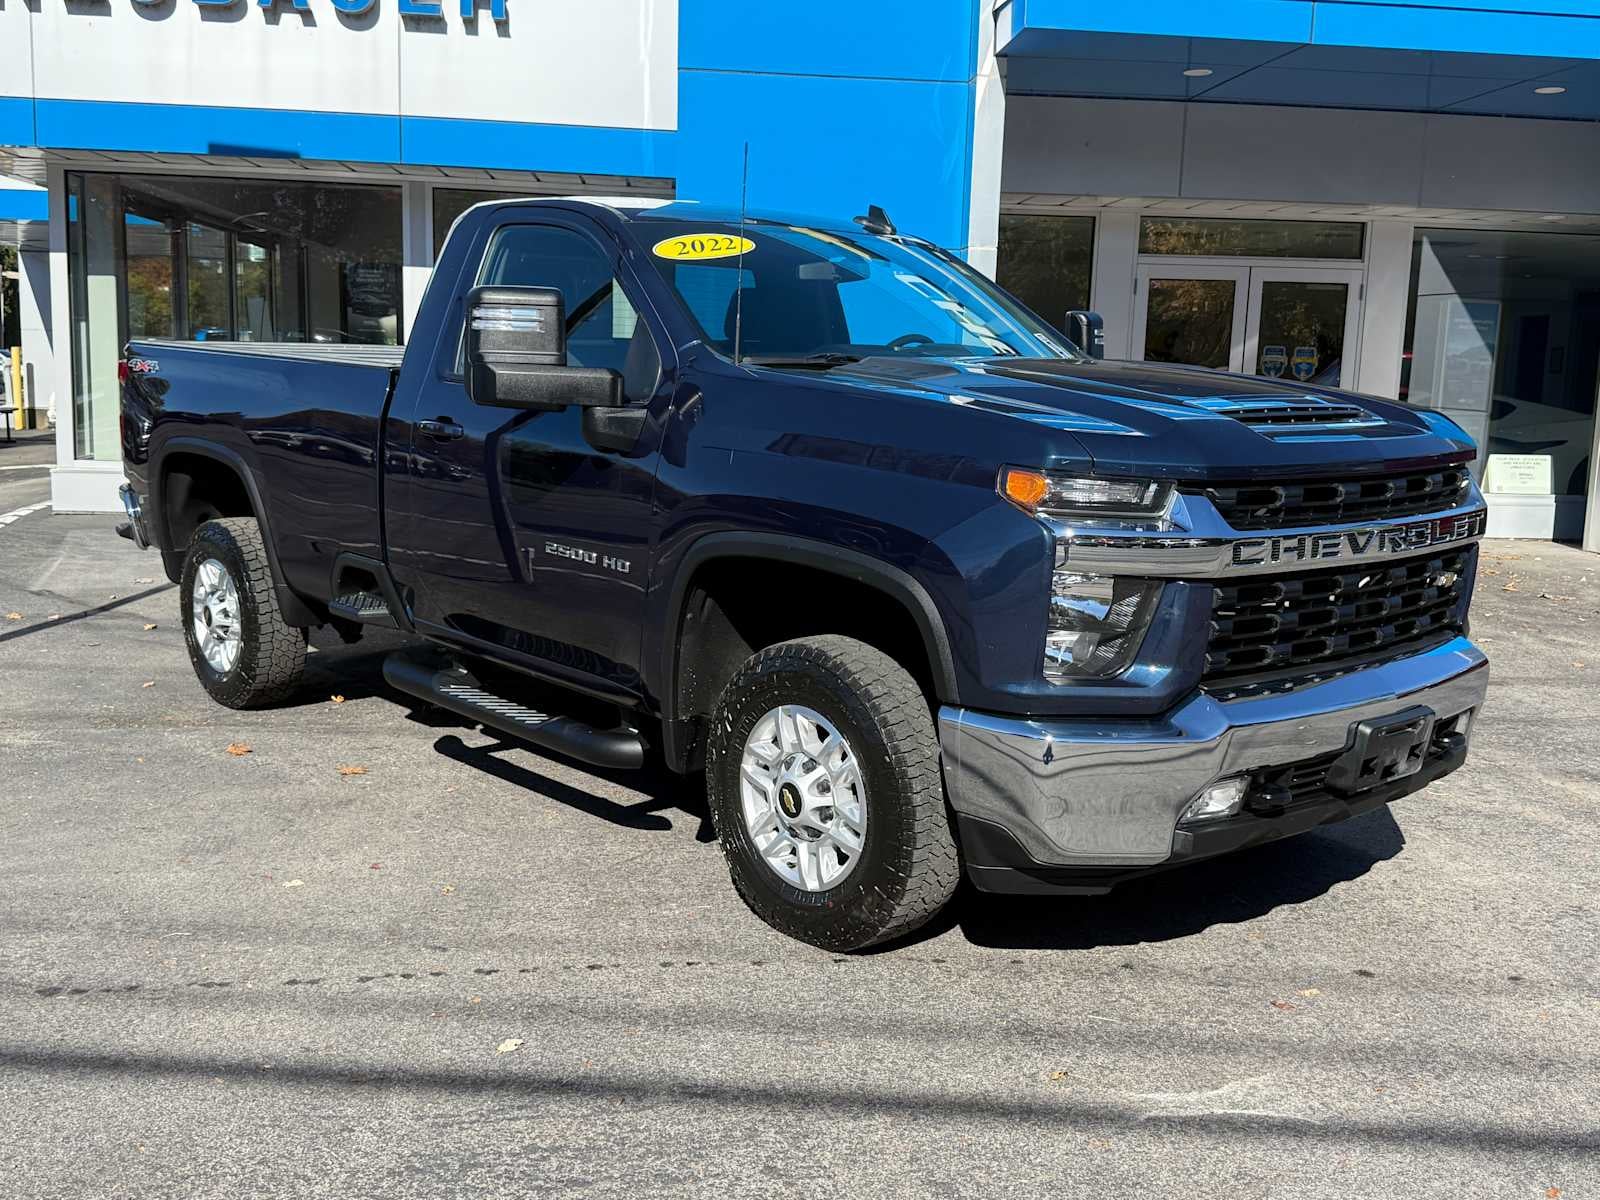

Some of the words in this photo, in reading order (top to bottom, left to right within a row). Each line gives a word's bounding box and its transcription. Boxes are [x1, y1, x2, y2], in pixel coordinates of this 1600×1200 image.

[674, 237, 736, 256] 2022
[1231, 511, 1485, 567] CHEVROLET
[545, 541, 598, 564] 2500
[602, 555, 630, 573] HD
